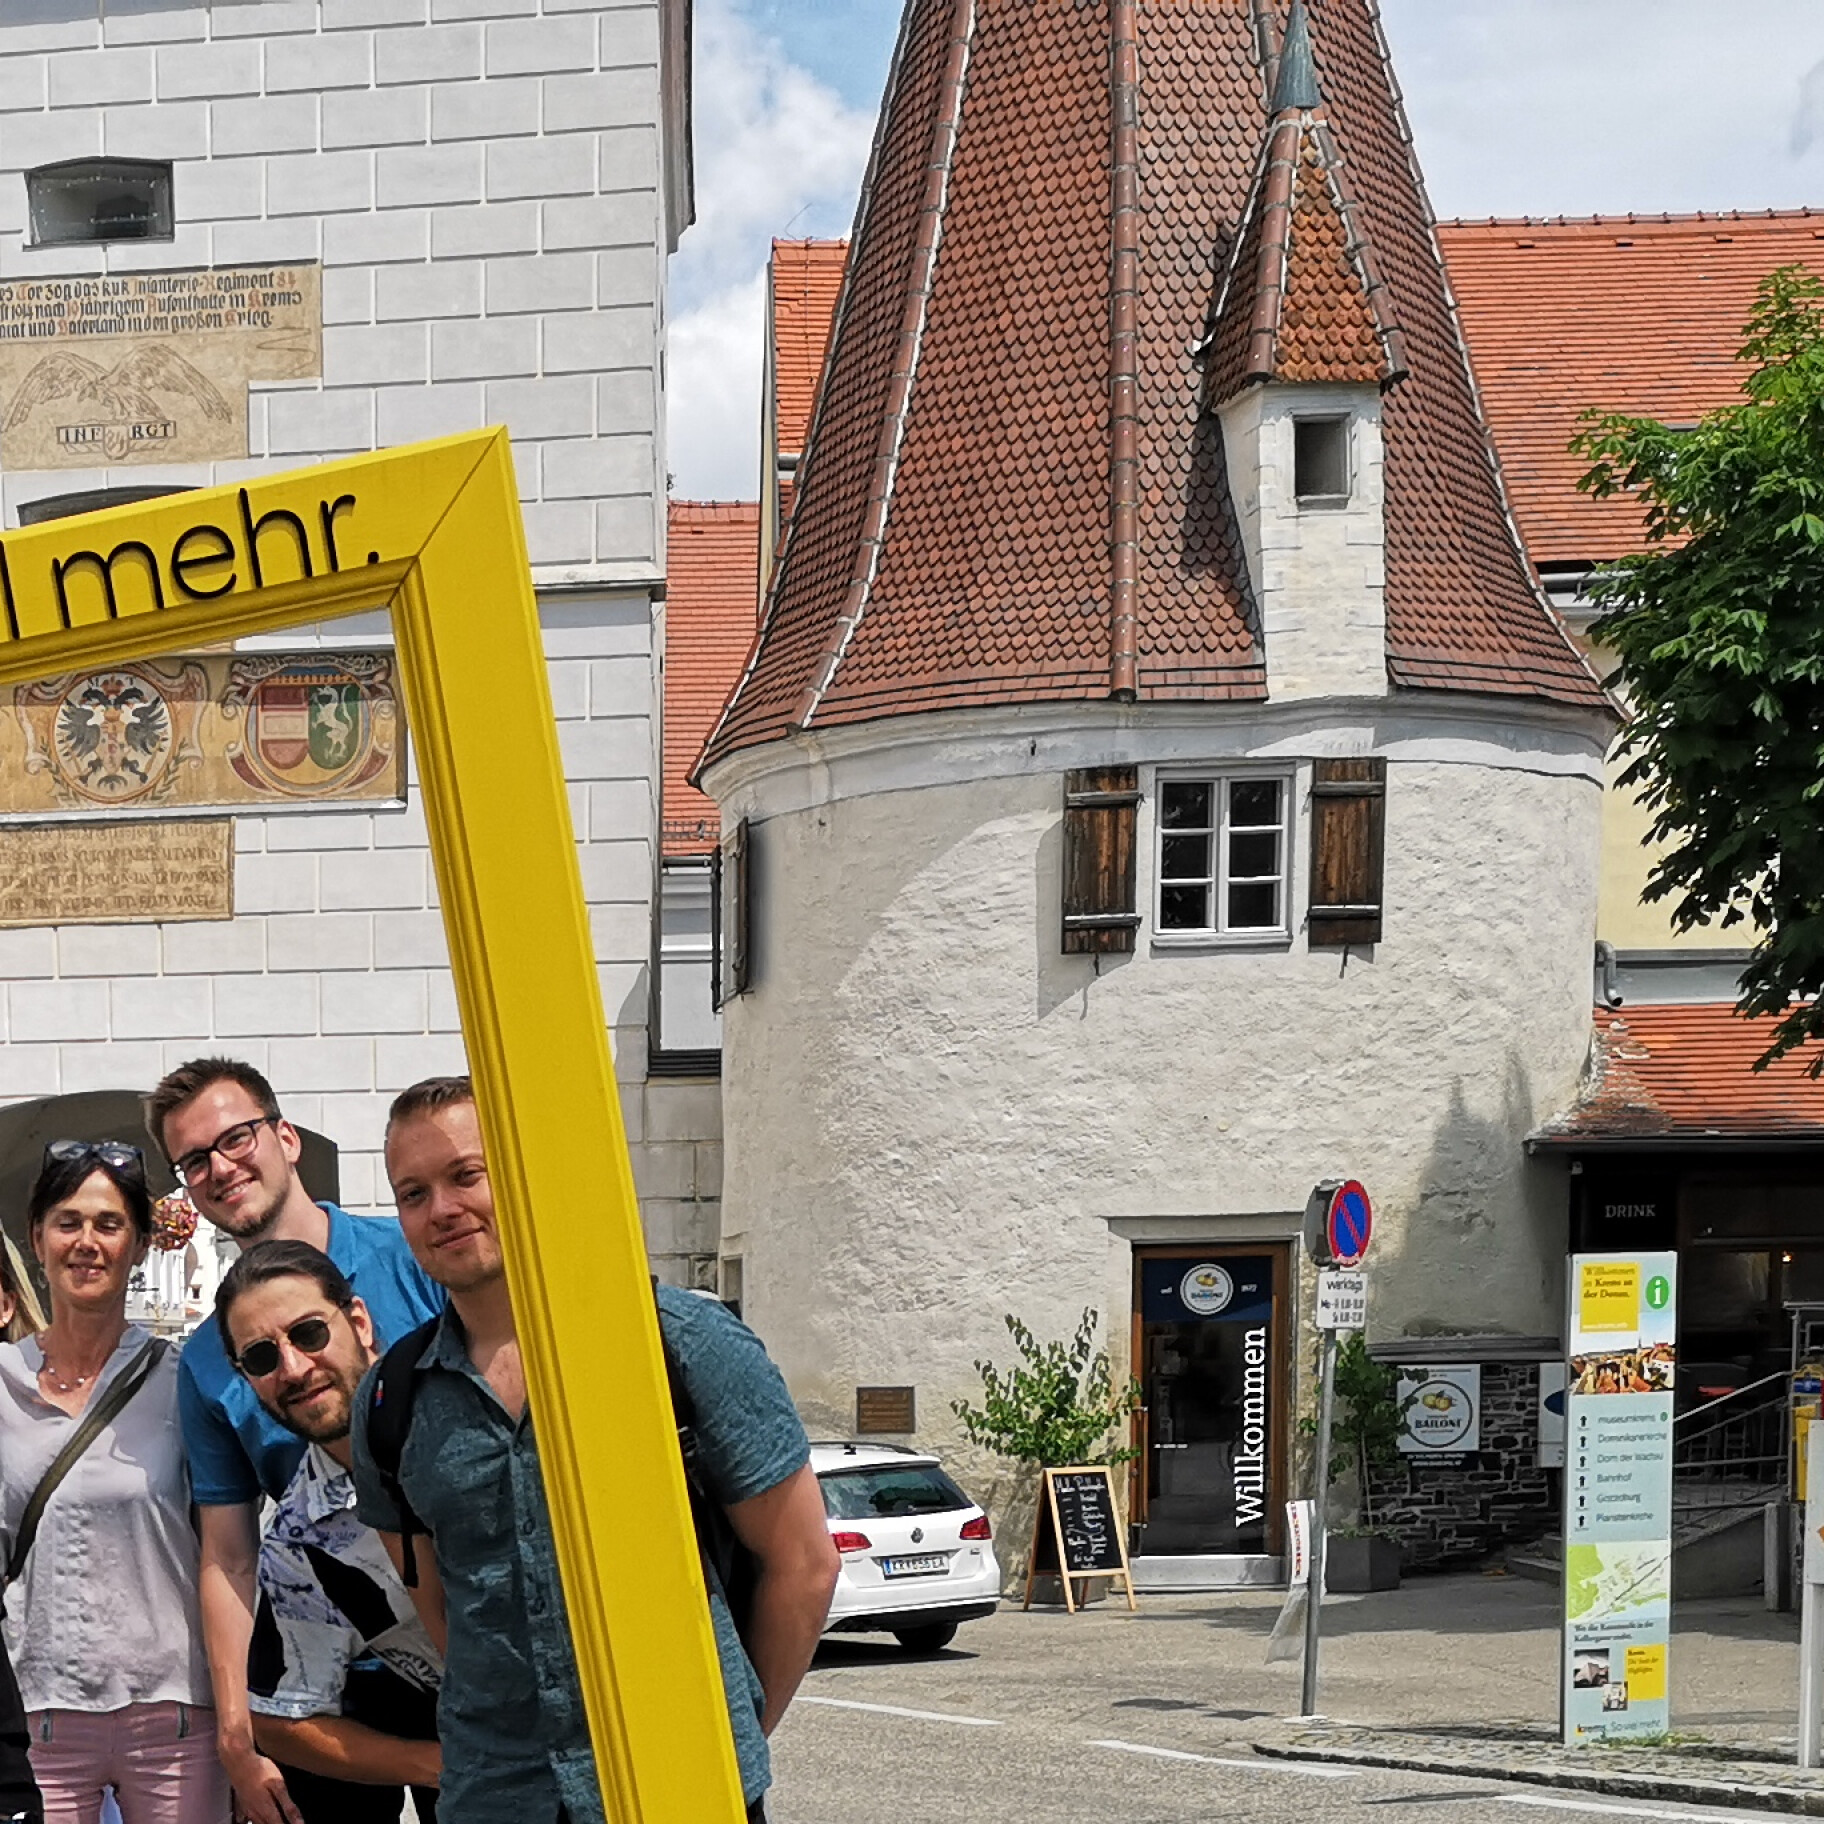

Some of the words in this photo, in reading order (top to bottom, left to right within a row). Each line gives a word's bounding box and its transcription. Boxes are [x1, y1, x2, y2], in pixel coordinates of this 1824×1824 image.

[16, 283, 43, 301] Tor
[44, 283, 72, 301] zog
[74, 280, 99, 298] das
[35, 301, 65, 319] nach
[229, 292, 245, 308] in
[247, 289, 302, 309] Krems
[28, 318, 56, 337] und
[57, 314, 125, 336] Vaterland
[127, 315, 142, 332] in
[143, 314, 169, 332] den
[171, 311, 222, 334] großen
[64, 426, 101, 443] INF
[131, 422, 171, 439] RGT
[52, 486, 381, 631] mehr.
[1604, 1203, 1656, 1218] DRINK
[1234, 1326, 1266, 1528] Willkommen
[1596, 1472, 1633, 1483] Bahnhof
